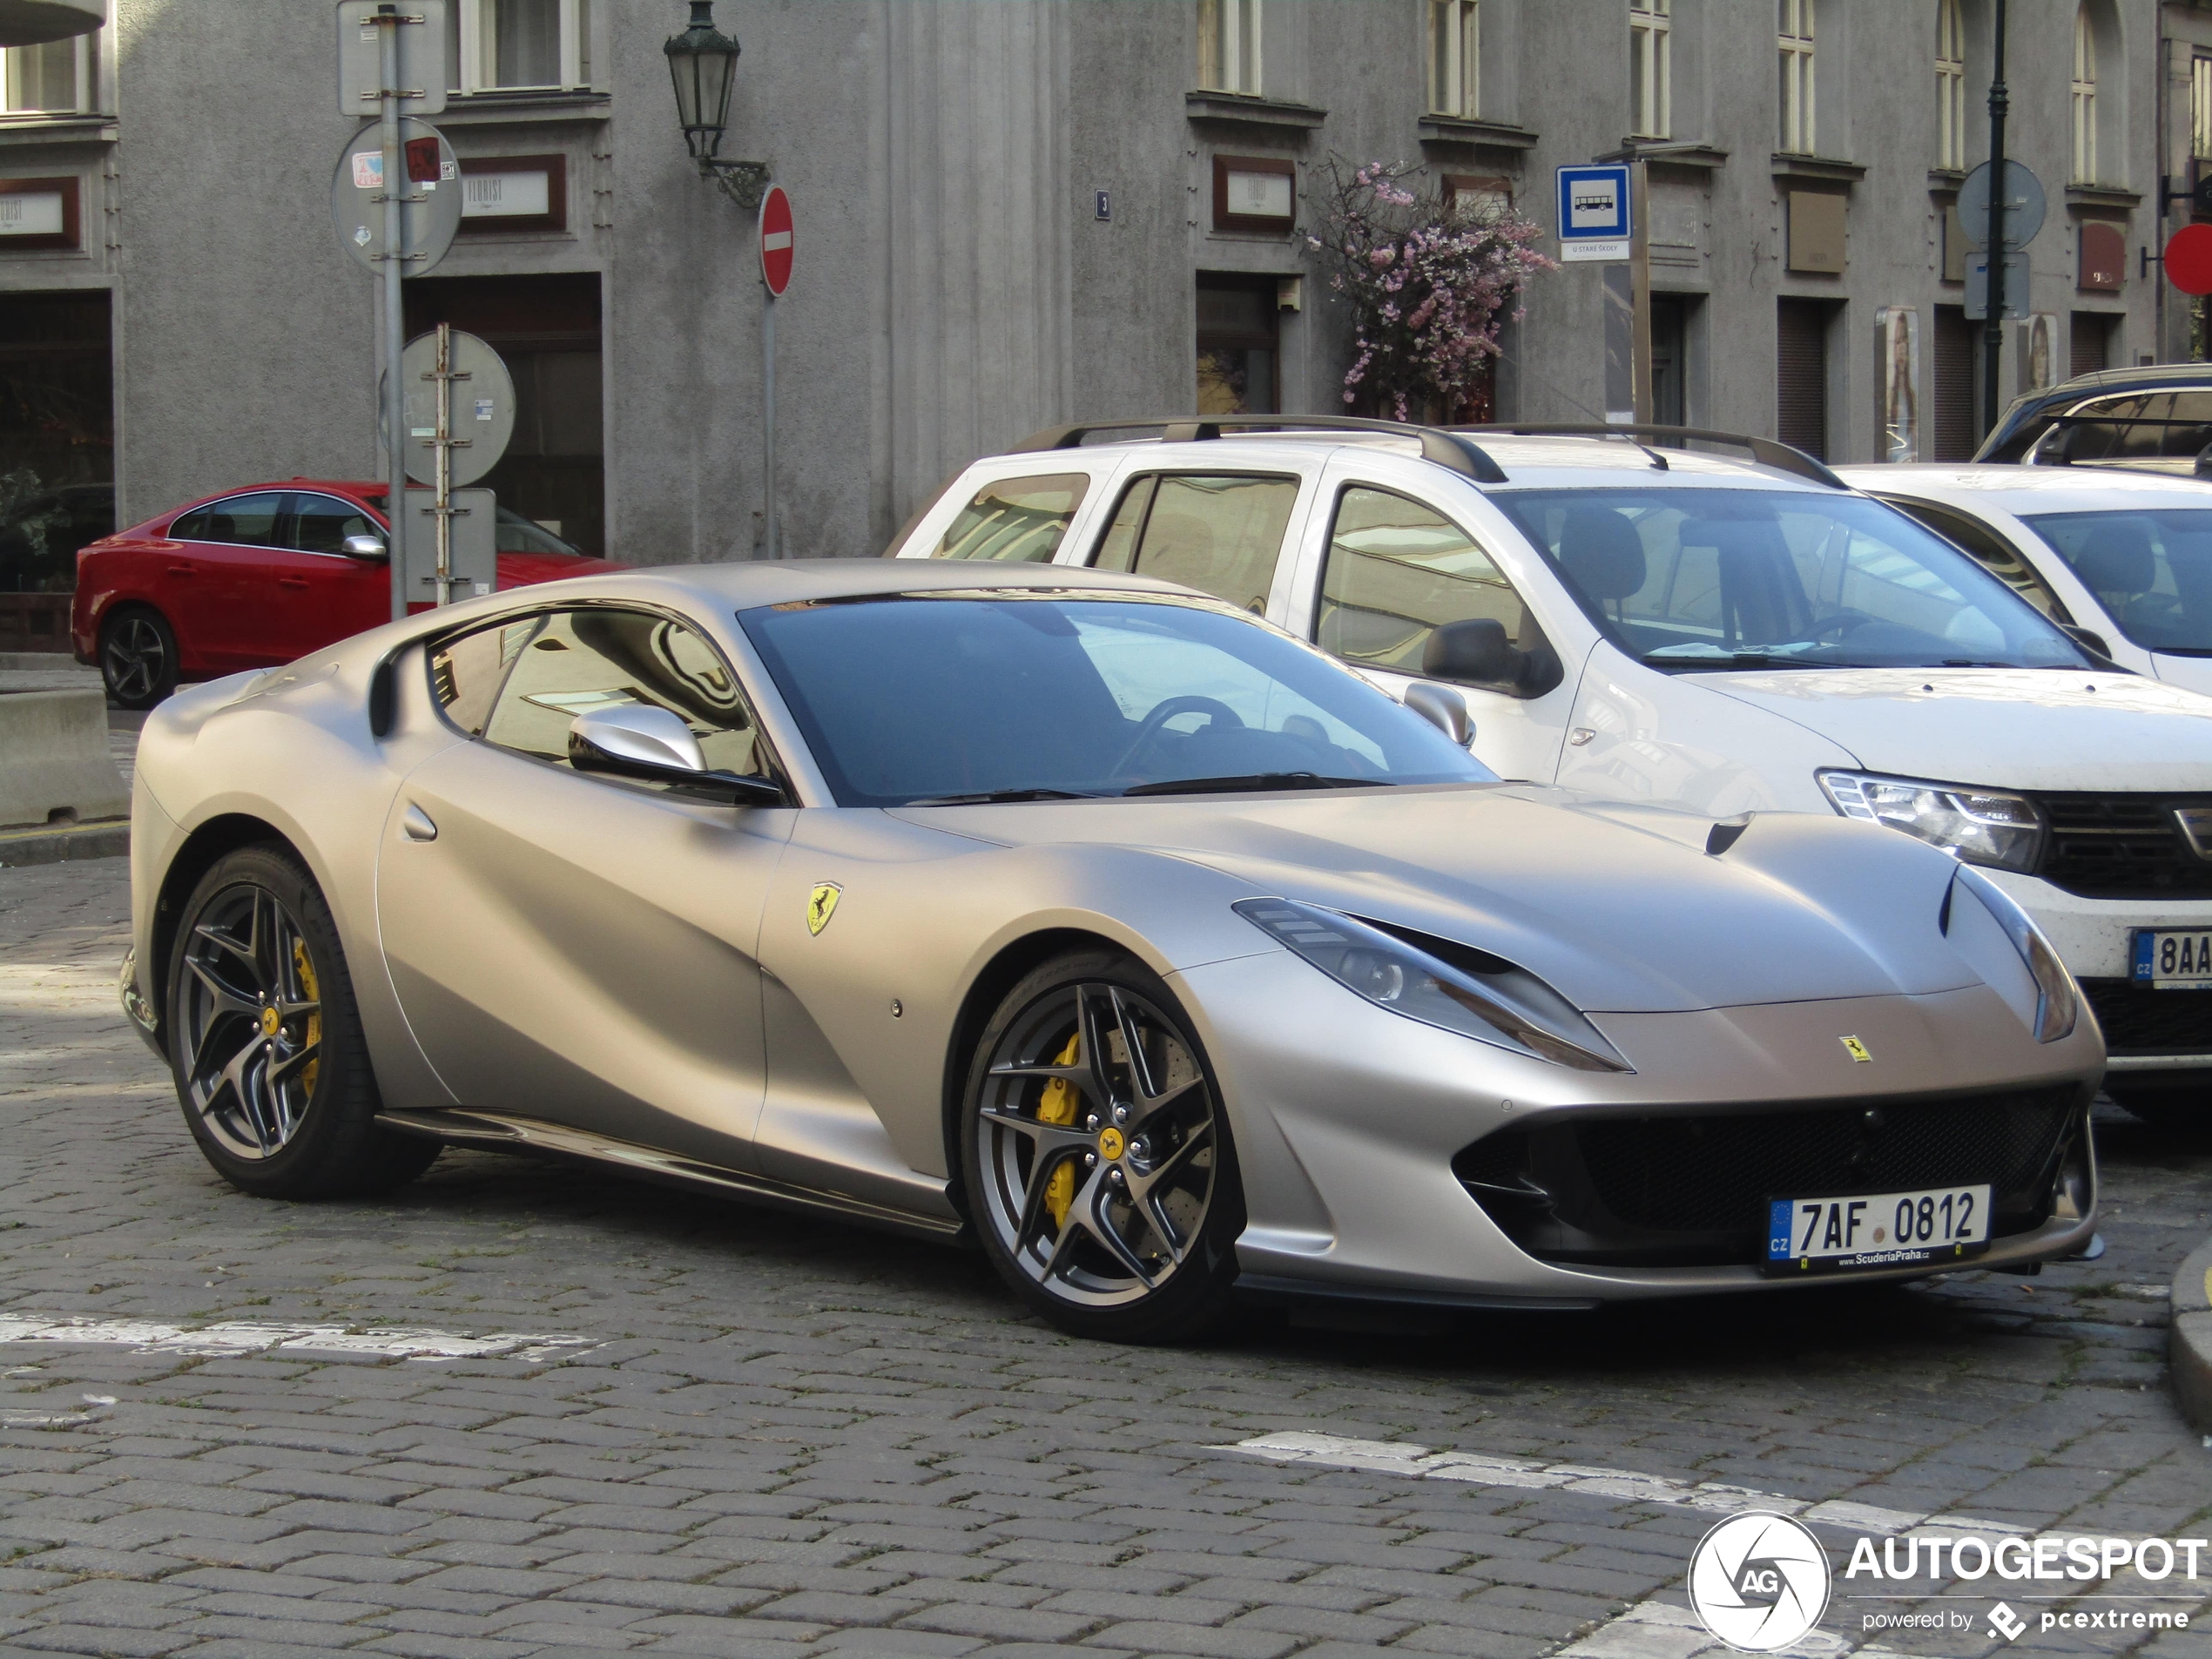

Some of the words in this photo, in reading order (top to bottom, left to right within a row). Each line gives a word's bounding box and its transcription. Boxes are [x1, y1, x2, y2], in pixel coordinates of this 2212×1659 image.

[469, 179, 502, 201] FLORIST
[1103, 197, 1108, 212] 3
[2161, 936, 2211, 974] 8AA
[2137, 963, 2150, 974] CZ
[1799, 1201, 1867, 1251] 7AF
[1894, 1192, 1973, 1244] 0812
[1770, 1238, 1788, 1251] CZ
[1838, 1251, 1930, 1266] www.ScuderiaPraha.cz
